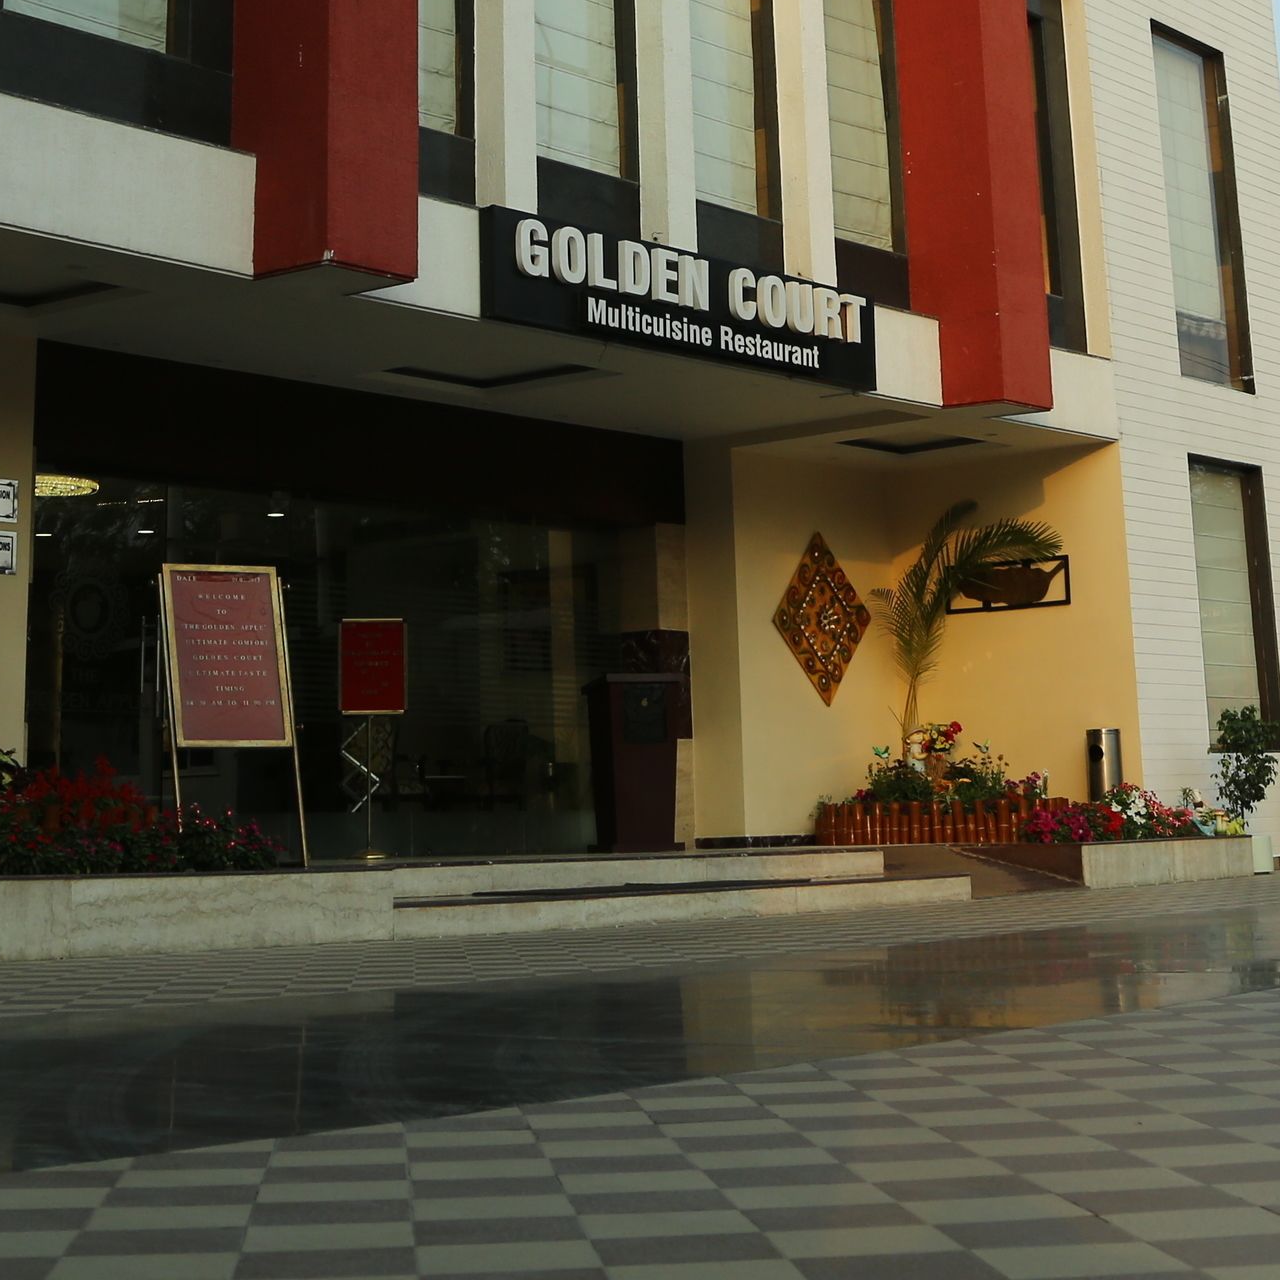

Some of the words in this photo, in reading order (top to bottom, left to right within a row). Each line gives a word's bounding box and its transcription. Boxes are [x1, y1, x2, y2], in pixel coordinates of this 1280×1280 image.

[515, 217, 710, 312] GOLDEN
[728, 267, 867, 344] COURT
[587, 296, 713, 347] Multicuisine
[720, 325, 820, 369] Restaurant
